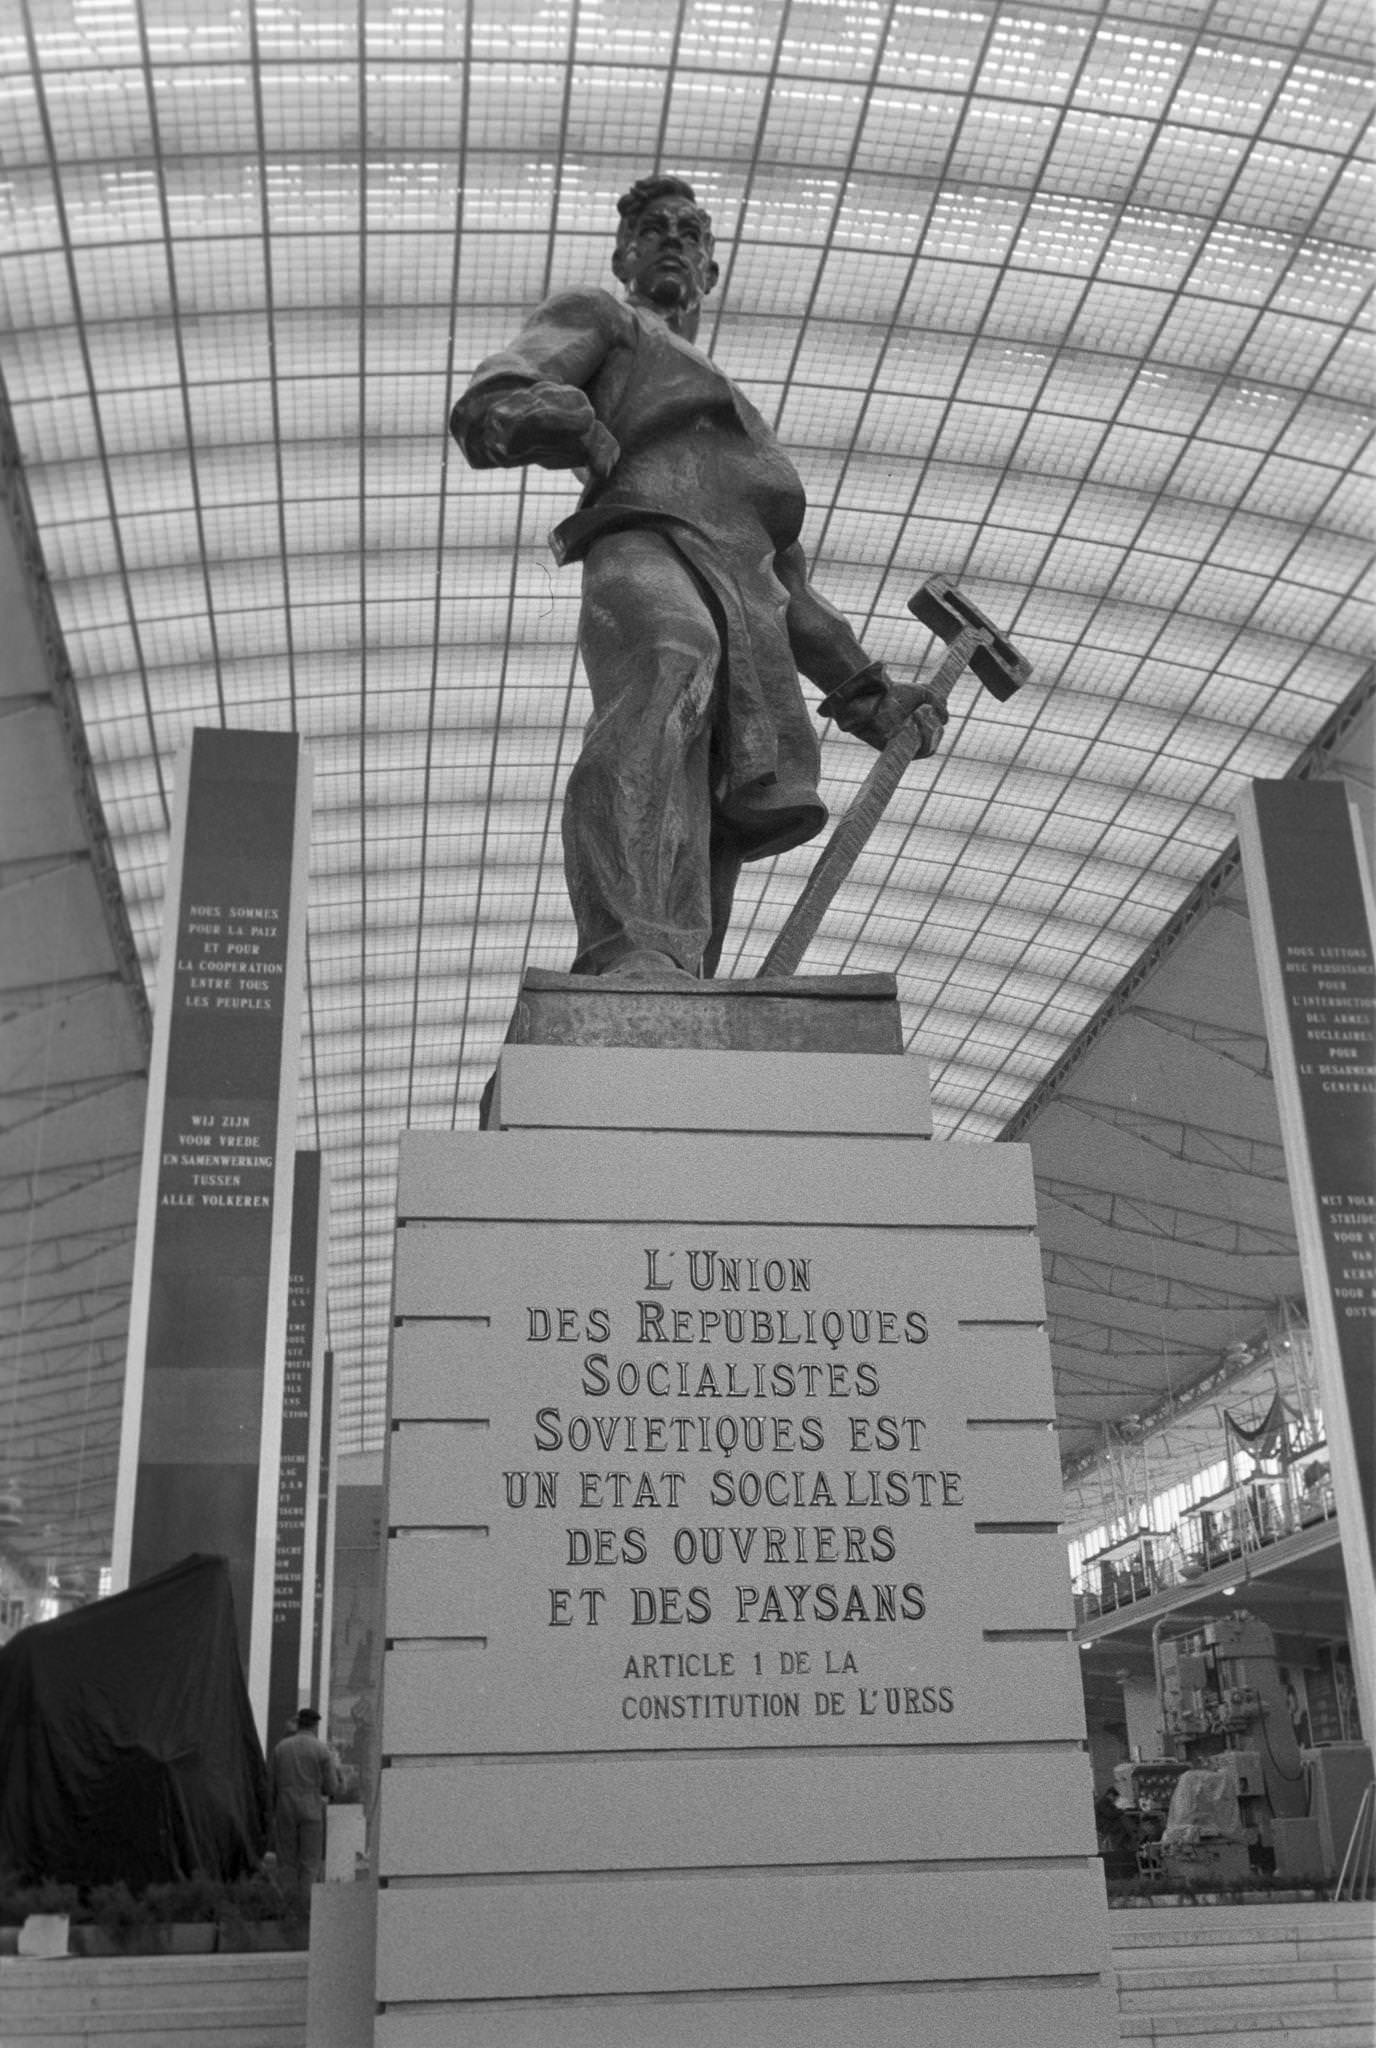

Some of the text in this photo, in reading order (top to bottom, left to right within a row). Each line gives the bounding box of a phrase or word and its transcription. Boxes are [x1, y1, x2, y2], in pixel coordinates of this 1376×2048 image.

[229, 906, 279, 919] SOMMES
[228, 925, 243, 935] LA
[251, 927, 277, 936] PAIX
[204, 943, 259, 954] ET POUR
[179, 960, 282, 974] LA COOPERATION
[191, 978, 269, 990] ENTRE TOUS
[186, 995, 271, 1008] LES PEUPLES
[192, 1115, 249, 1127] WIJ ZIJN
[180, 1135, 260, 1147] VOOR VREDE
[163, 1155, 273, 1167] EN SAMENWERKING
[192, 1175, 240, 1186] TUSSEN
[162, 1194, 269, 1207] ALLE VOLKEREN
[644, 1249, 812, 1292] L'UNION
[526, 1300, 928, 1350] DES REPUBLIQUES
[582, 1353, 880, 1397] SOCIALISTES
[534, 1408, 926, 1457] SOVIETIQUES EST
[503, 1469, 964, 1508] UN ETAT SOCIALISTE
[566, 1525, 896, 1565] DES OUVRIERS
[549, 1583, 926, 1626] ET DES PAYSANS
[624, 1650, 859, 1678] ARTICLE 1 DE LA
[621, 1686, 954, 1720] CONSTITUTION DE L'URSS
